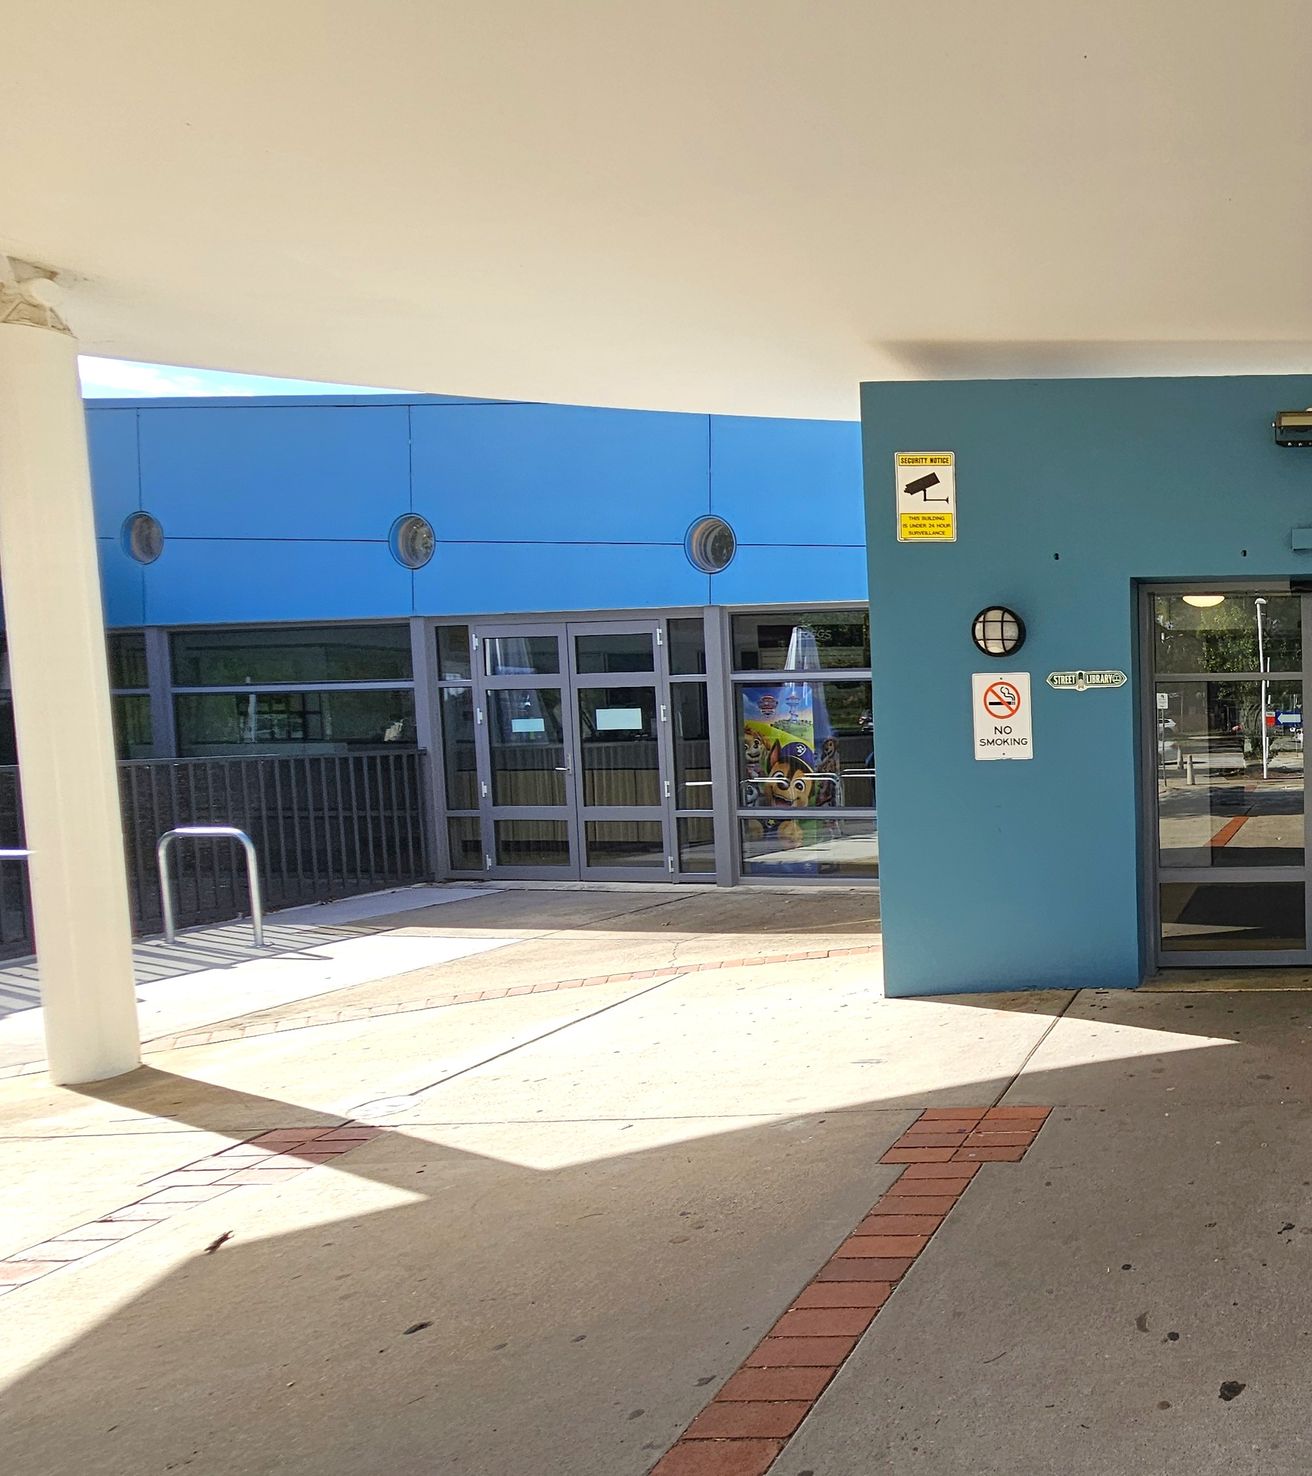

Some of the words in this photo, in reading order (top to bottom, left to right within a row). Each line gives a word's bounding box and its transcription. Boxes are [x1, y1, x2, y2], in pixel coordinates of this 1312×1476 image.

[1053, 675, 1076, 685] STREET
[1086, 673, 1113, 684] LIBRARY
[994, 725, 1013, 735] NO
[979, 737, 1028, 747] SMOKING
